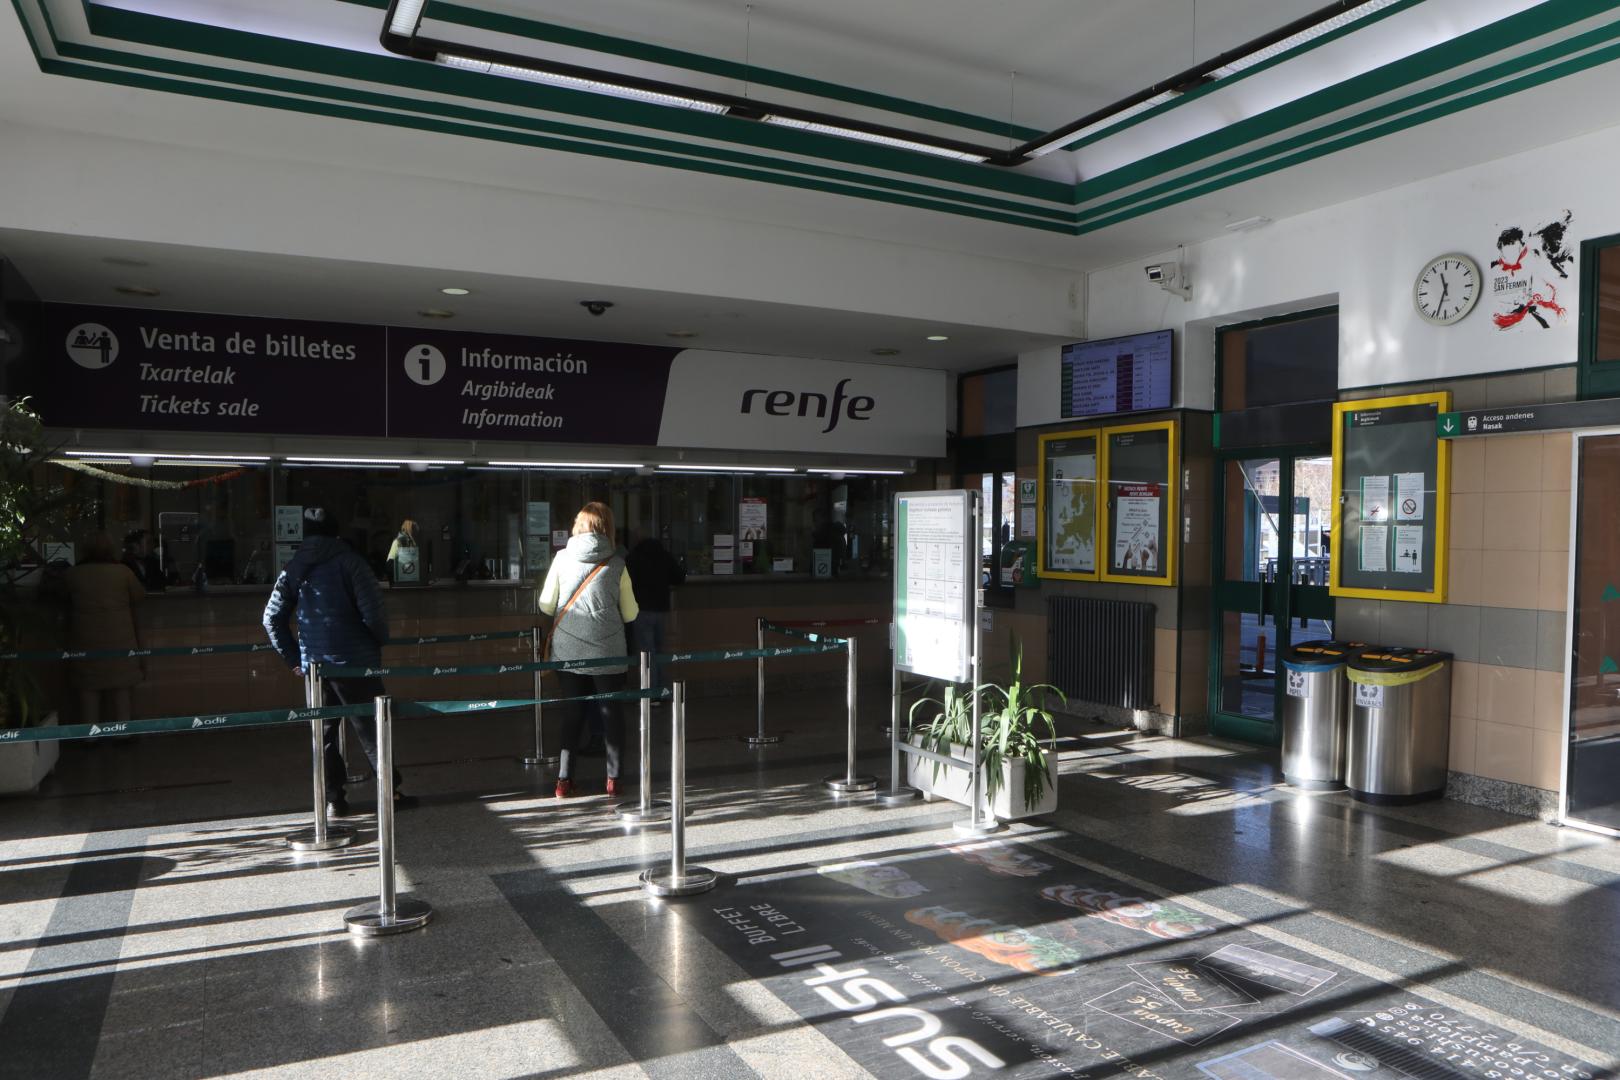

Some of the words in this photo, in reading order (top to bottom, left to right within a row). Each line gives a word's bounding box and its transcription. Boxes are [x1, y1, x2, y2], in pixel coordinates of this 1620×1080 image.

[1494, 281, 1504, 292] SAN
[140, 326, 215, 352] Venta
[225, 332, 256, 354] de
[266, 334, 356, 360] billetes
[461, 348, 588, 374] Información
[140, 363, 236, 384] Txartelak
[461, 380, 556, 400] Argibideak
[140, 394, 211, 415] Tickets
[217, 398, 260, 416] sale
[740, 378, 875, 434] renfe
[462, 408, 564, 428] Information
[204, 716, 228, 726] adif
[299, 710, 320, 718] adif
[103, 723, 128, 732] adif
[712, 906, 776, 946] BUFFET
[750, 902, 806, 936] LIBRE
[1169, 967, 1199, 980] 5€
[988, 984, 1011, 997] UN
[1162, 976, 1203, 1002] Cupón
[1126, 995, 1162, 1010] 5€
[1008, 998, 1102, 1050] CANJEABLE
[1134, 1008, 1194, 1034] Cupón
[1380, 1024, 1424, 1046] 945
[1100, 1047, 1162, 1080] ABLE.
[1431, 1046, 1476, 1068] 414
